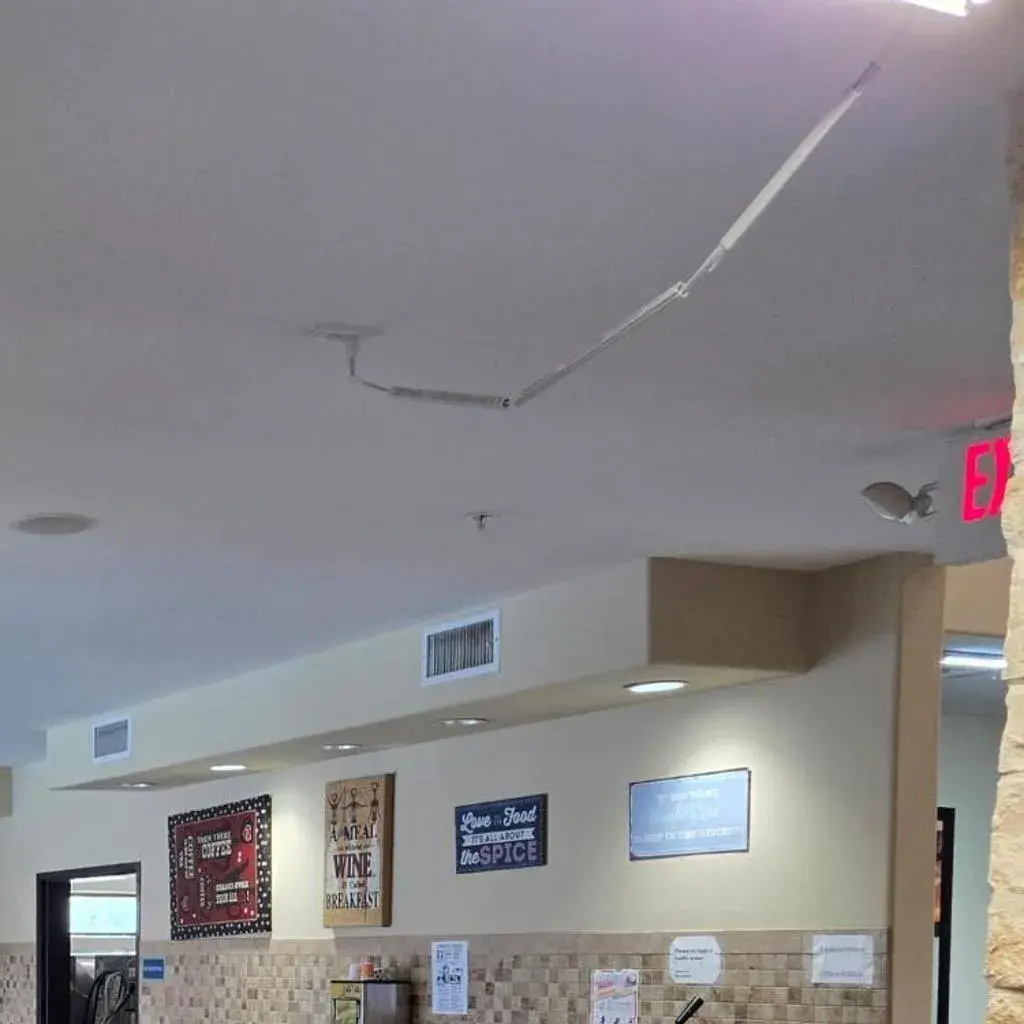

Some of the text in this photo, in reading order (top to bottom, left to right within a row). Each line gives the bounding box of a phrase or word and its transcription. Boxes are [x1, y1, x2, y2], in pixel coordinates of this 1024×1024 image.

[459, 811, 491, 834] Love
[503, 805, 537, 827] Food
[201, 840, 232, 859] COFFEE
[460, 840, 538, 866] the SPICE
[333, 852, 373, 879] WINE
[325, 890, 380, 910] BREAKFAST
